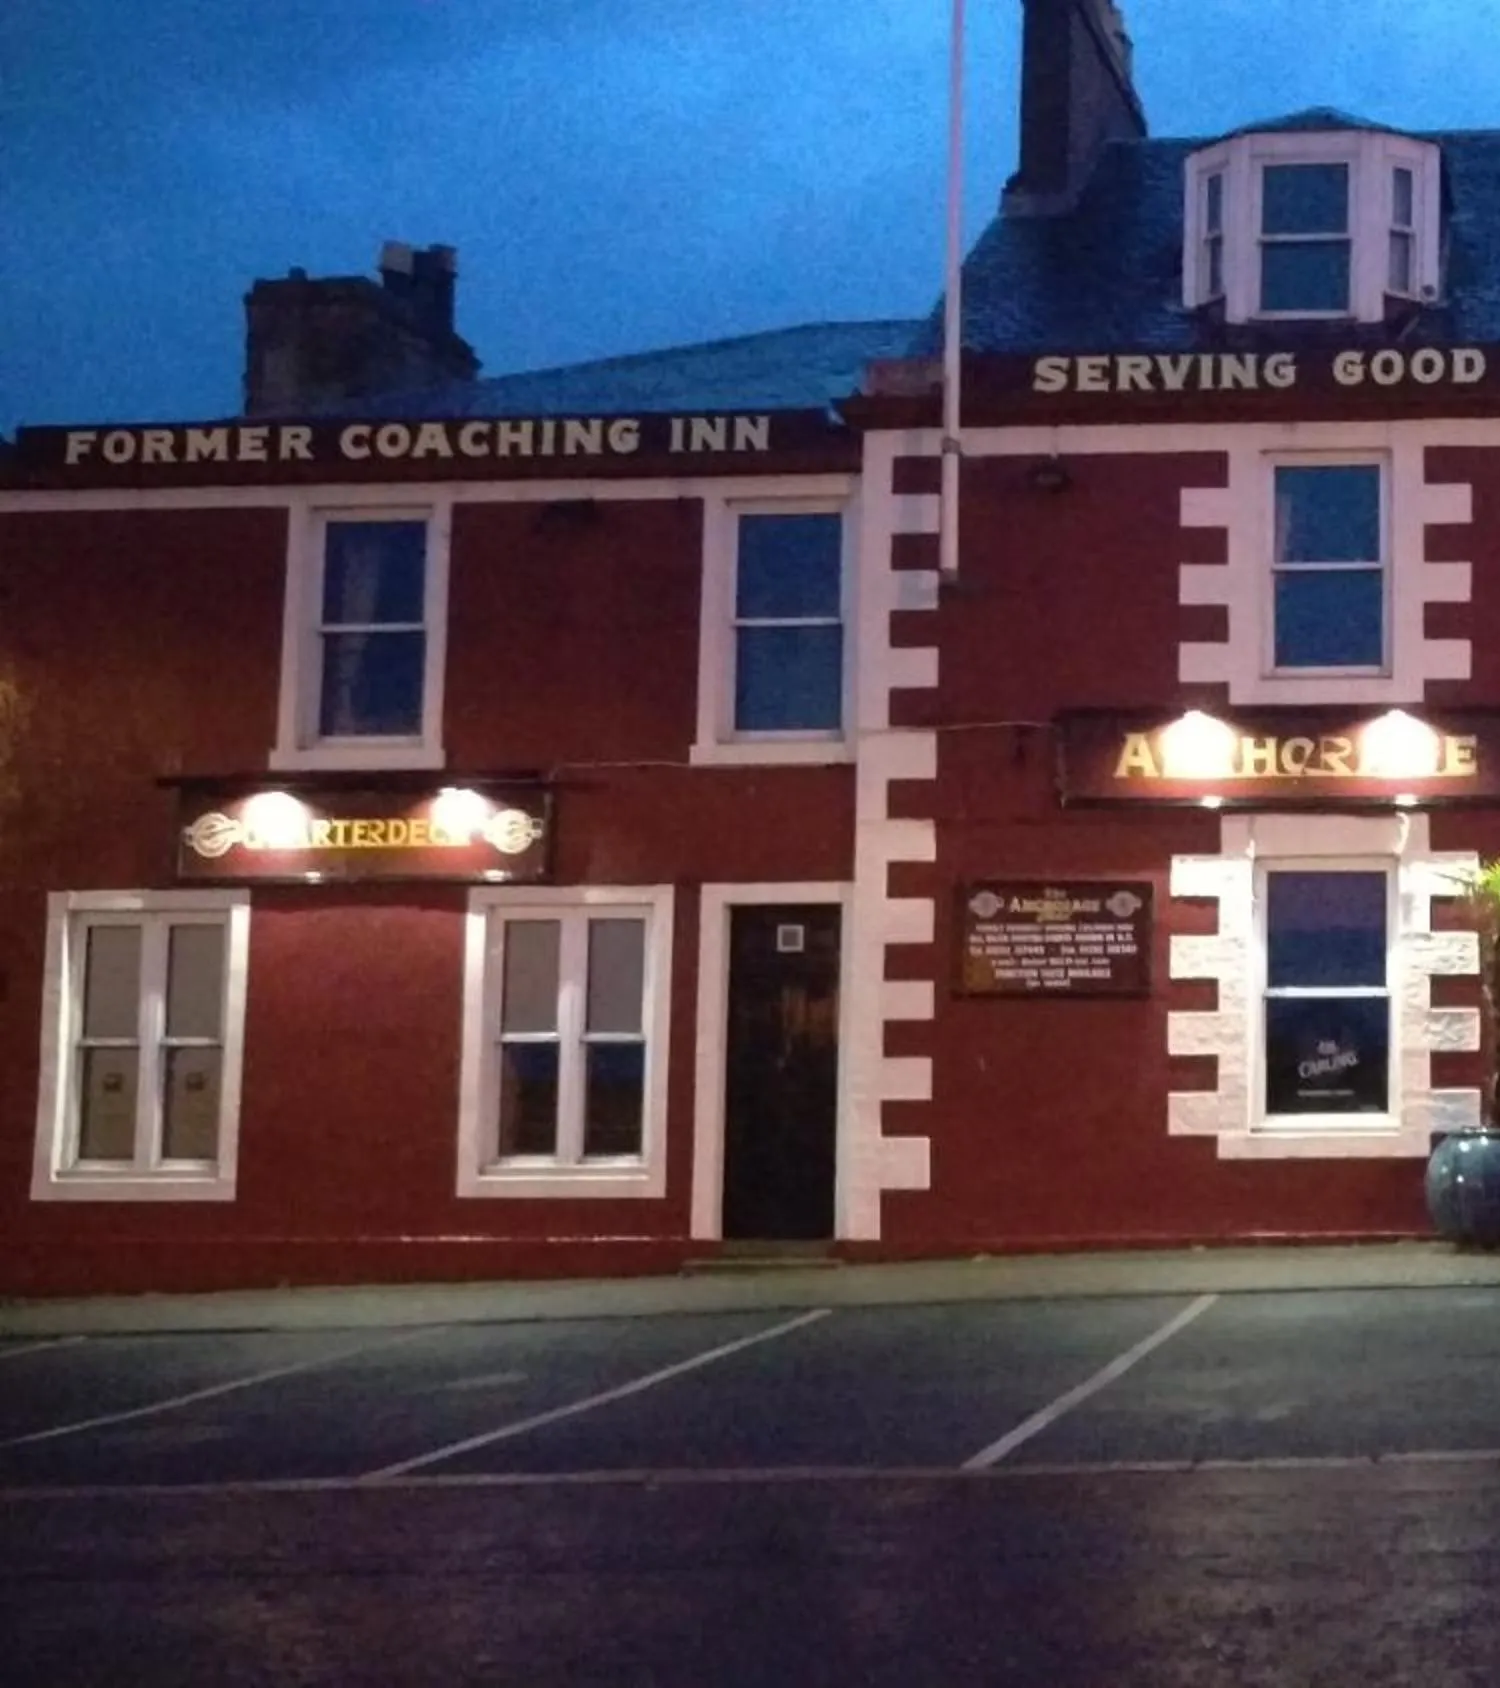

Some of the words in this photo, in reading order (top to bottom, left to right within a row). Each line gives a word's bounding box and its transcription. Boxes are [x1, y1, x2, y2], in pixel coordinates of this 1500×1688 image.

[1032, 351, 1297, 393] SERVING
[1331, 347, 1487, 385] GOOD
[64, 424, 315, 465] FORMER
[338, 416, 641, 460] COACHING
[669, 415, 772, 453] INN
[1114, 733, 1478, 778] AHORE
